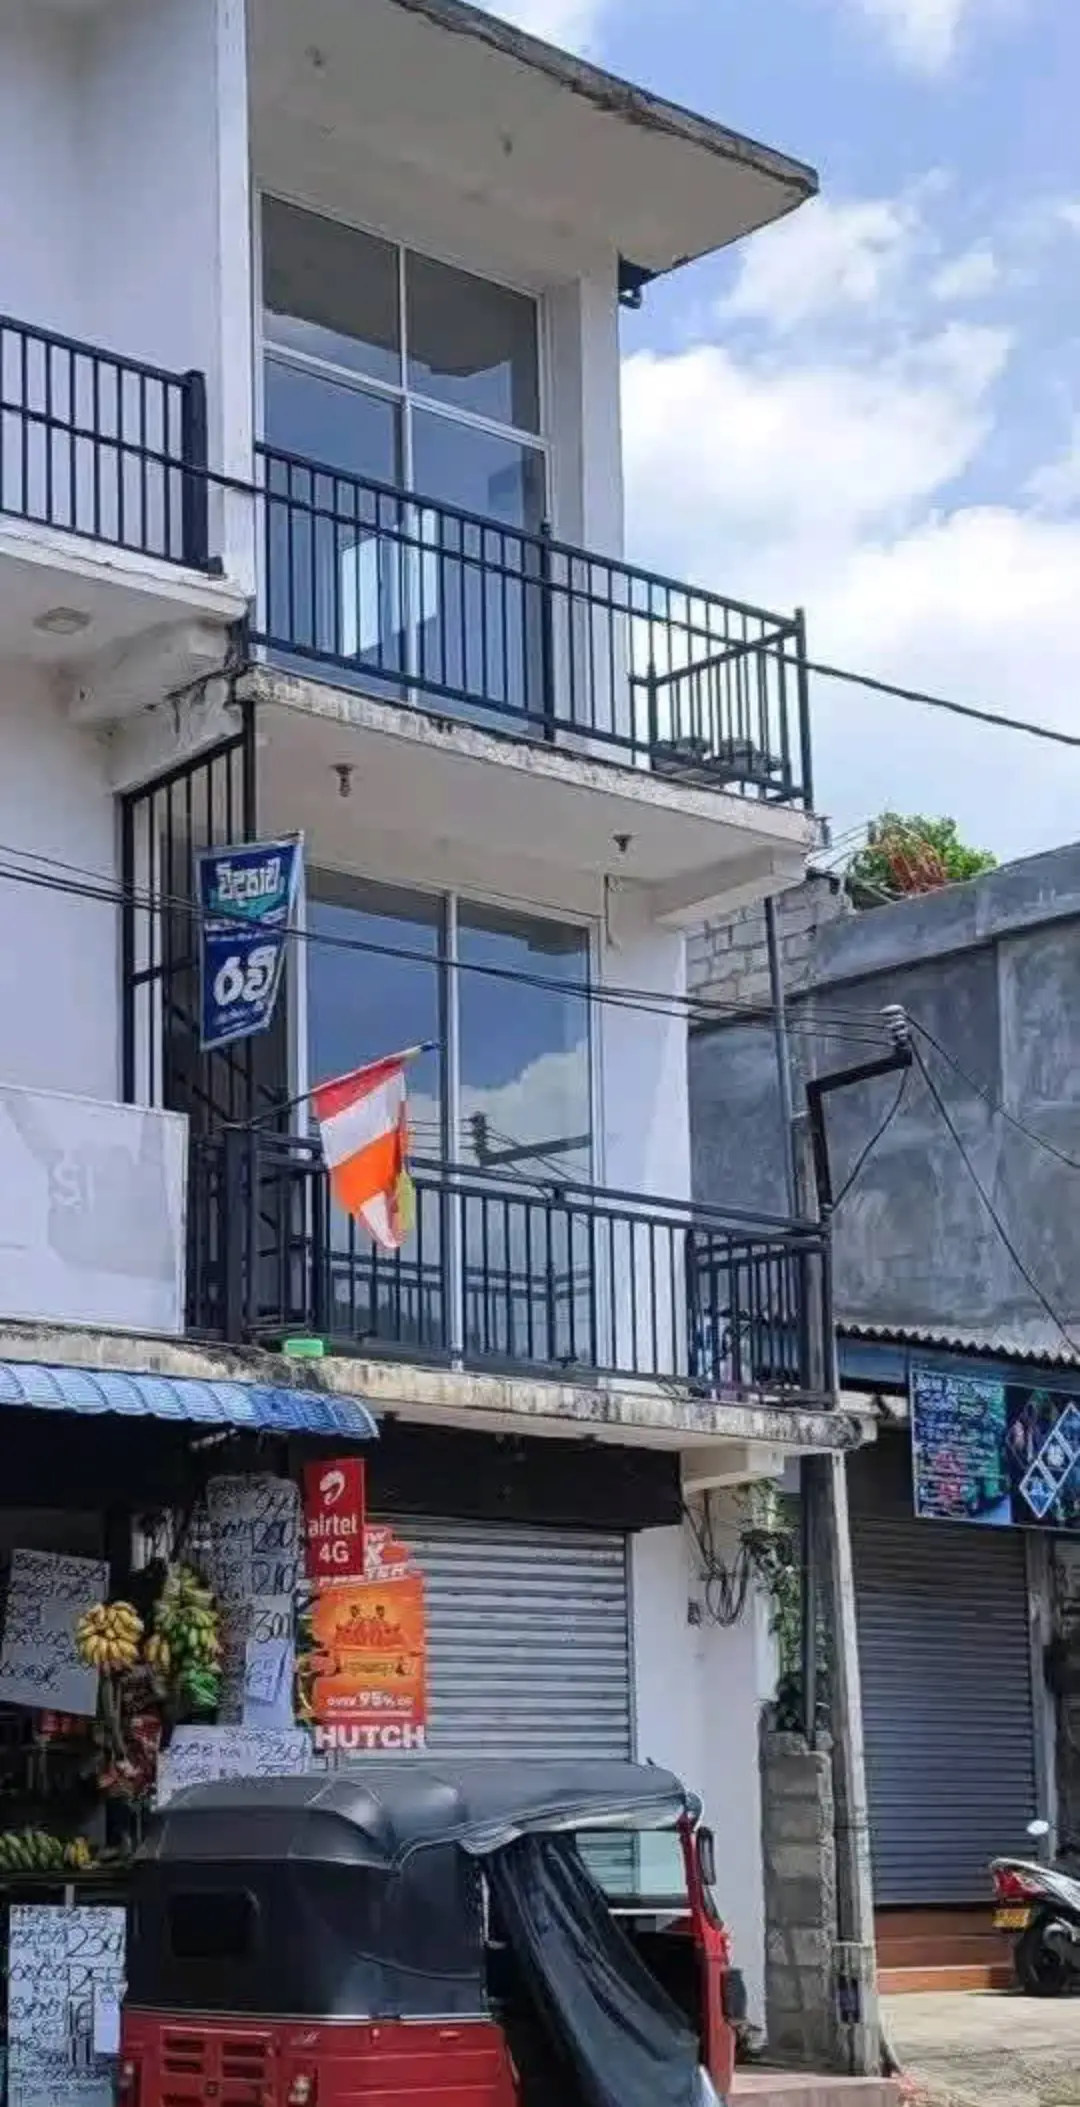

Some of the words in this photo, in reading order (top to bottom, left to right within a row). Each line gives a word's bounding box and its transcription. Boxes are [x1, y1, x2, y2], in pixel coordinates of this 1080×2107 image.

[308, 1513, 359, 1538] airtel
[319, 1540, 350, 1564] 4G
[315, 1723, 427, 1749] HUTCH
